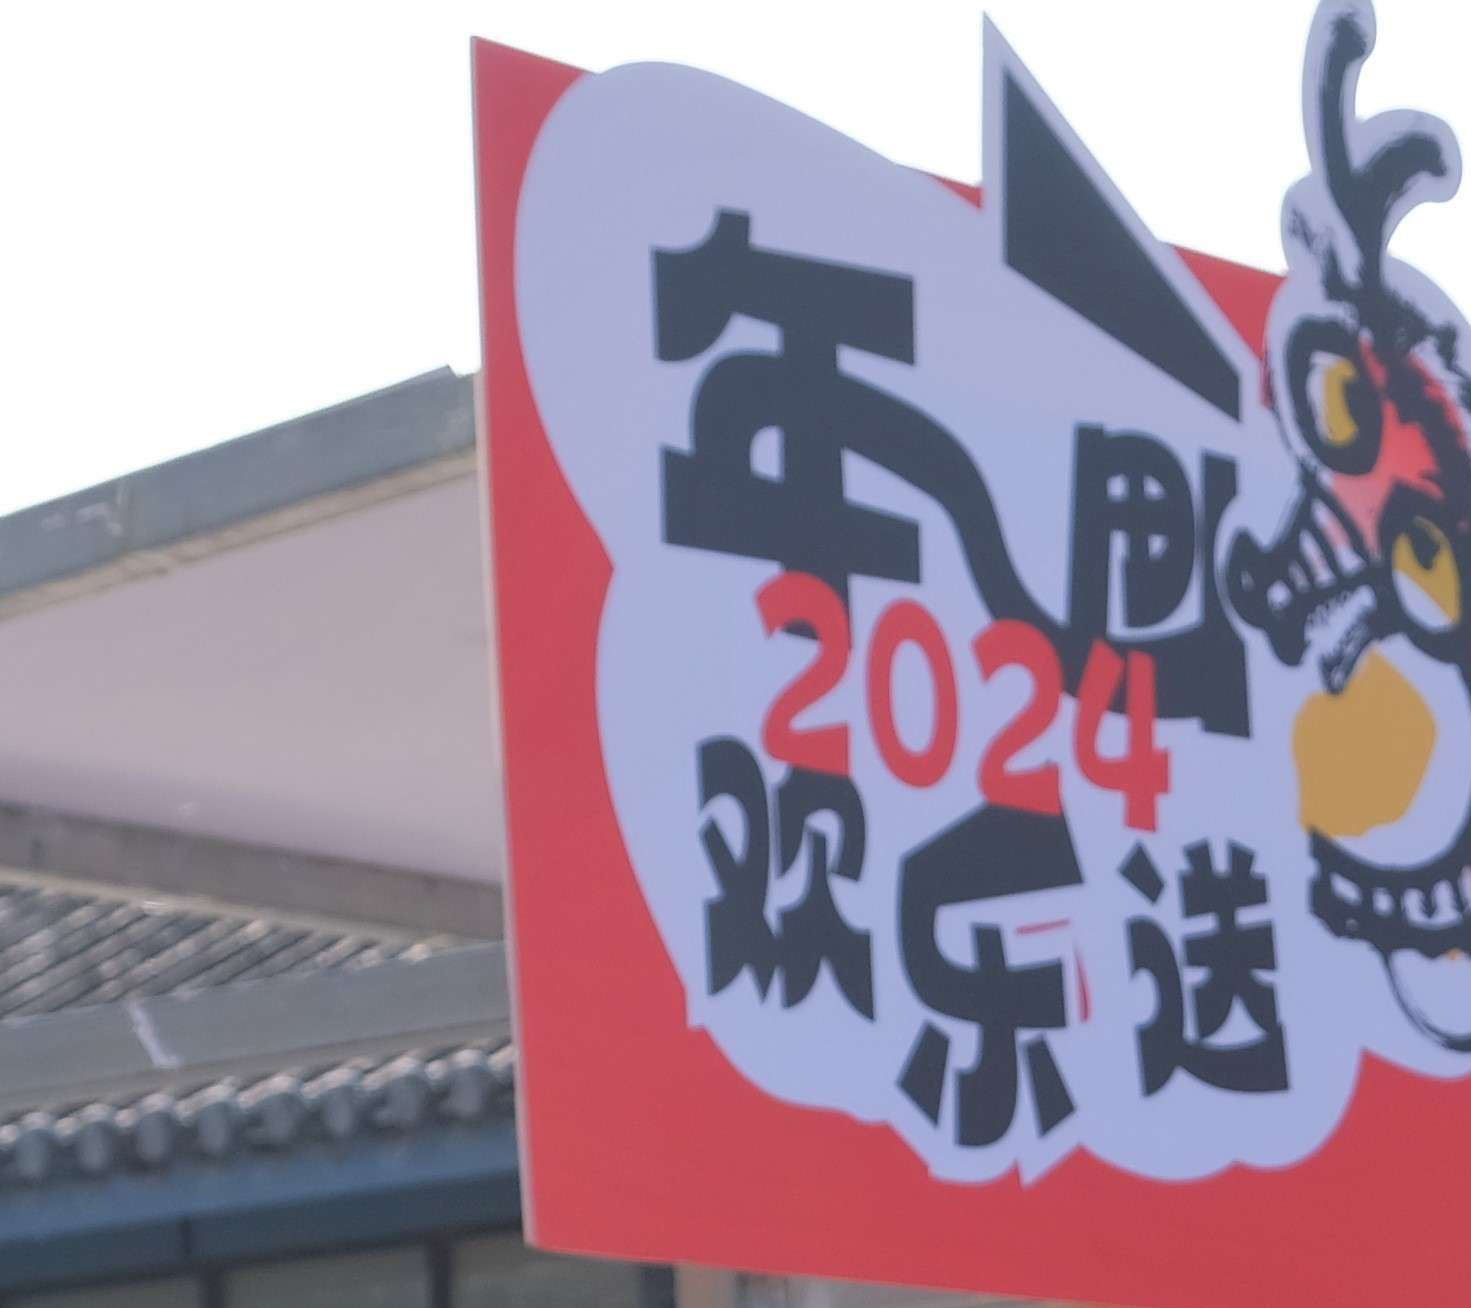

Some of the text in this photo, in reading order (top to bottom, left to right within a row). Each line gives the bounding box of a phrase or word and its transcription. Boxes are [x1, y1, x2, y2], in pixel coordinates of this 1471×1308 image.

[754, 570, 1171, 834] 2024
[694, 735, 1292, 1149] 欢乐送
